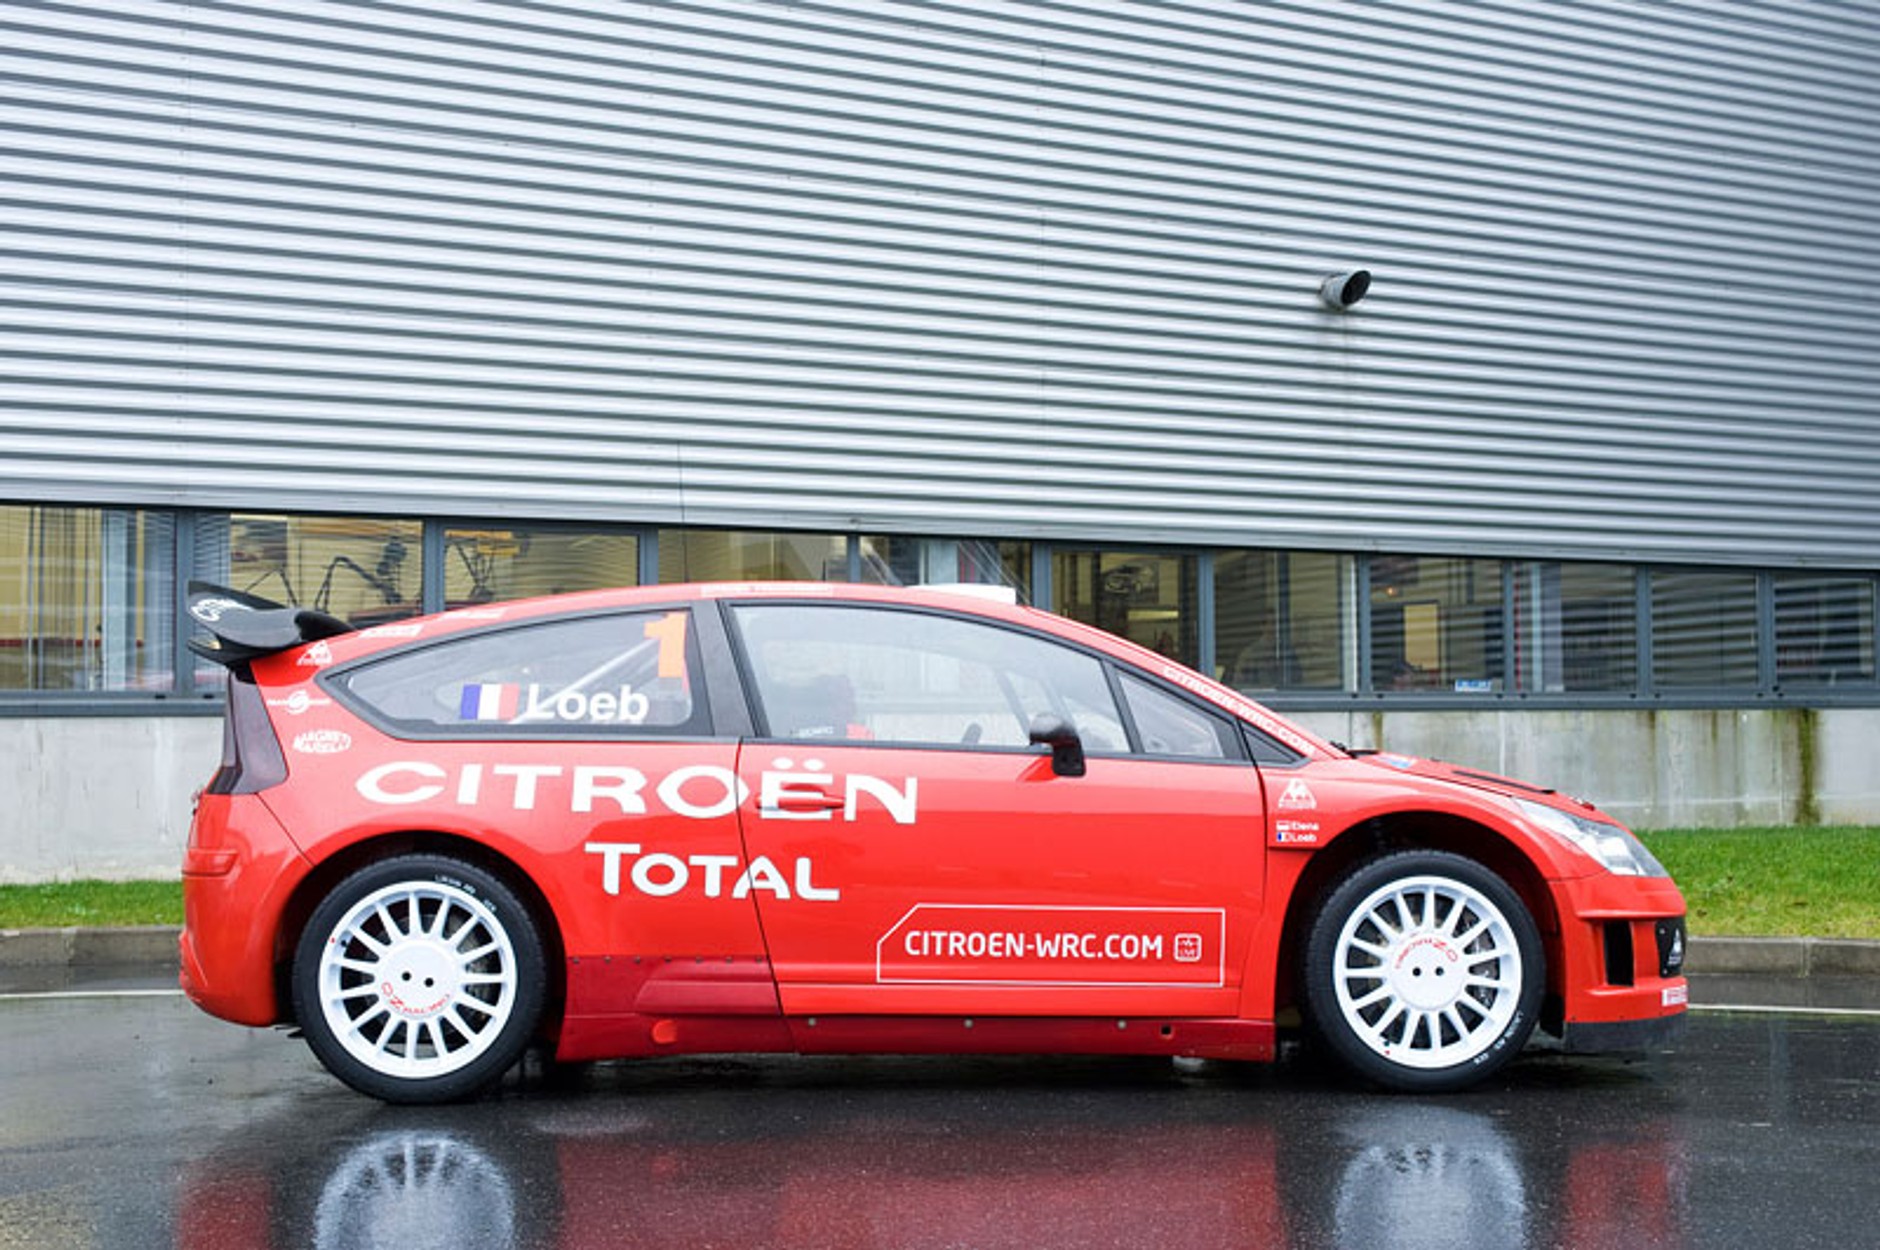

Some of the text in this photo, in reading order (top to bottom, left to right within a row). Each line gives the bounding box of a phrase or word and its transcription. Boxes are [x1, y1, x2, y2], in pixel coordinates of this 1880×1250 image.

[643, 611, 687, 678] 1
[526, 683, 650, 721] Loeb
[356, 757, 917, 824] CITROËN
[904, 931, 1163, 959] CITROEN-WRC.COM
